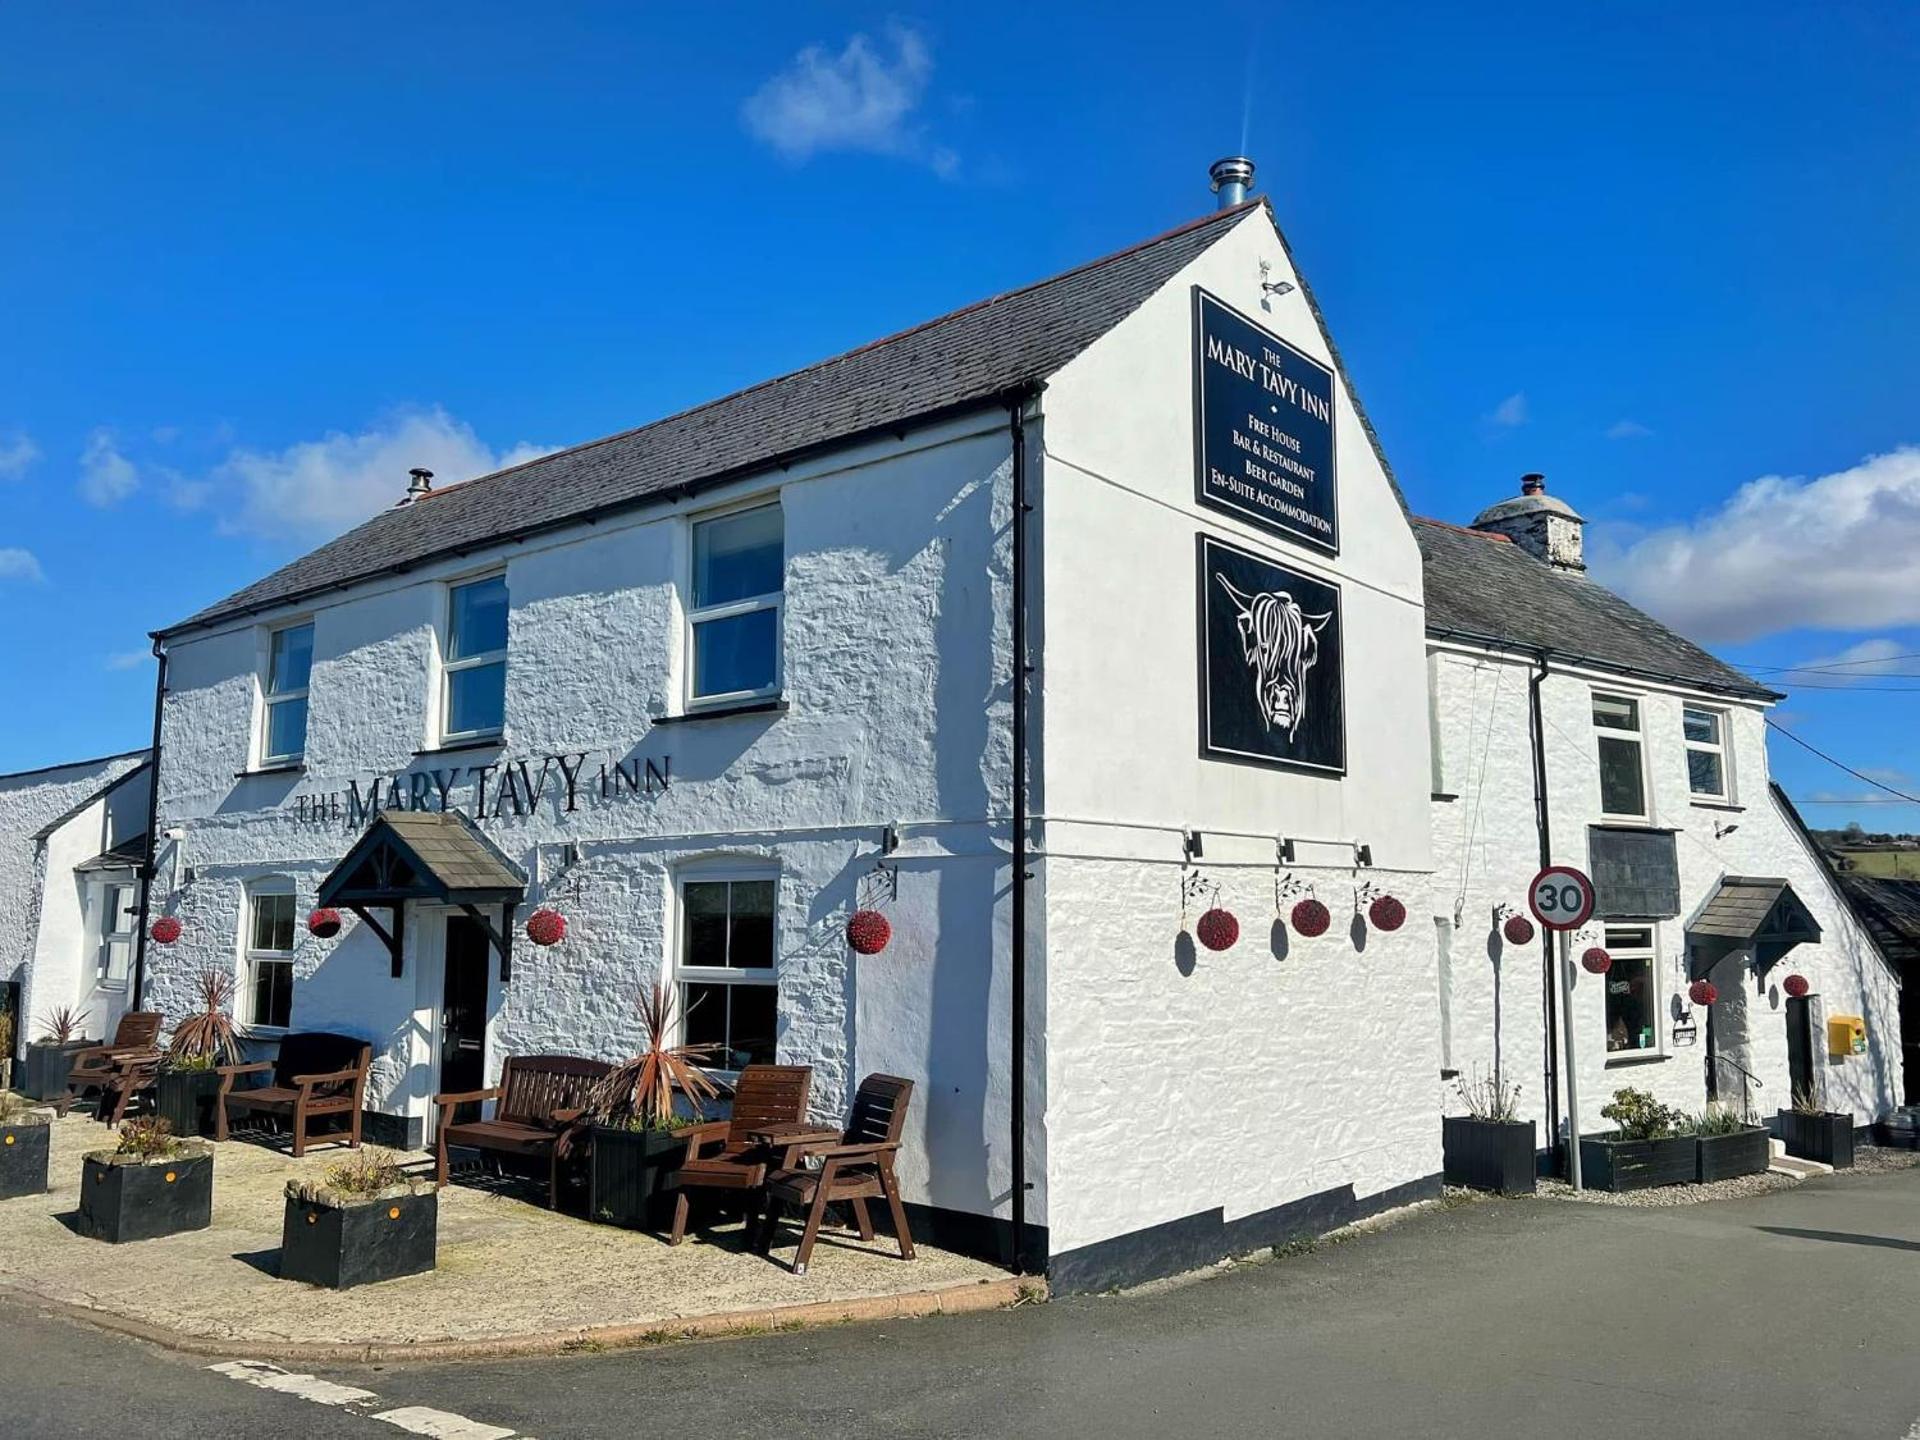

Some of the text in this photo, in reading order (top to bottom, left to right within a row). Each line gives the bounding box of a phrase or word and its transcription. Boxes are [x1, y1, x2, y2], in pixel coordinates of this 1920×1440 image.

[1207, 334, 1330, 425] MARY TAVY INN
[1263, 346, 1281, 368] THE
[1233, 429, 1316, 482] BAR & RESTAURANT
[1248, 413, 1301, 454] FREE HOUSE
[1211, 467, 1332, 535] EN-SUITE ACCOMMODATION
[1245, 459, 1304, 500] BEER GARDEN
[296, 751, 672, 829] THE MARY TAVY INN
[1538, 884, 1582, 912] 30
